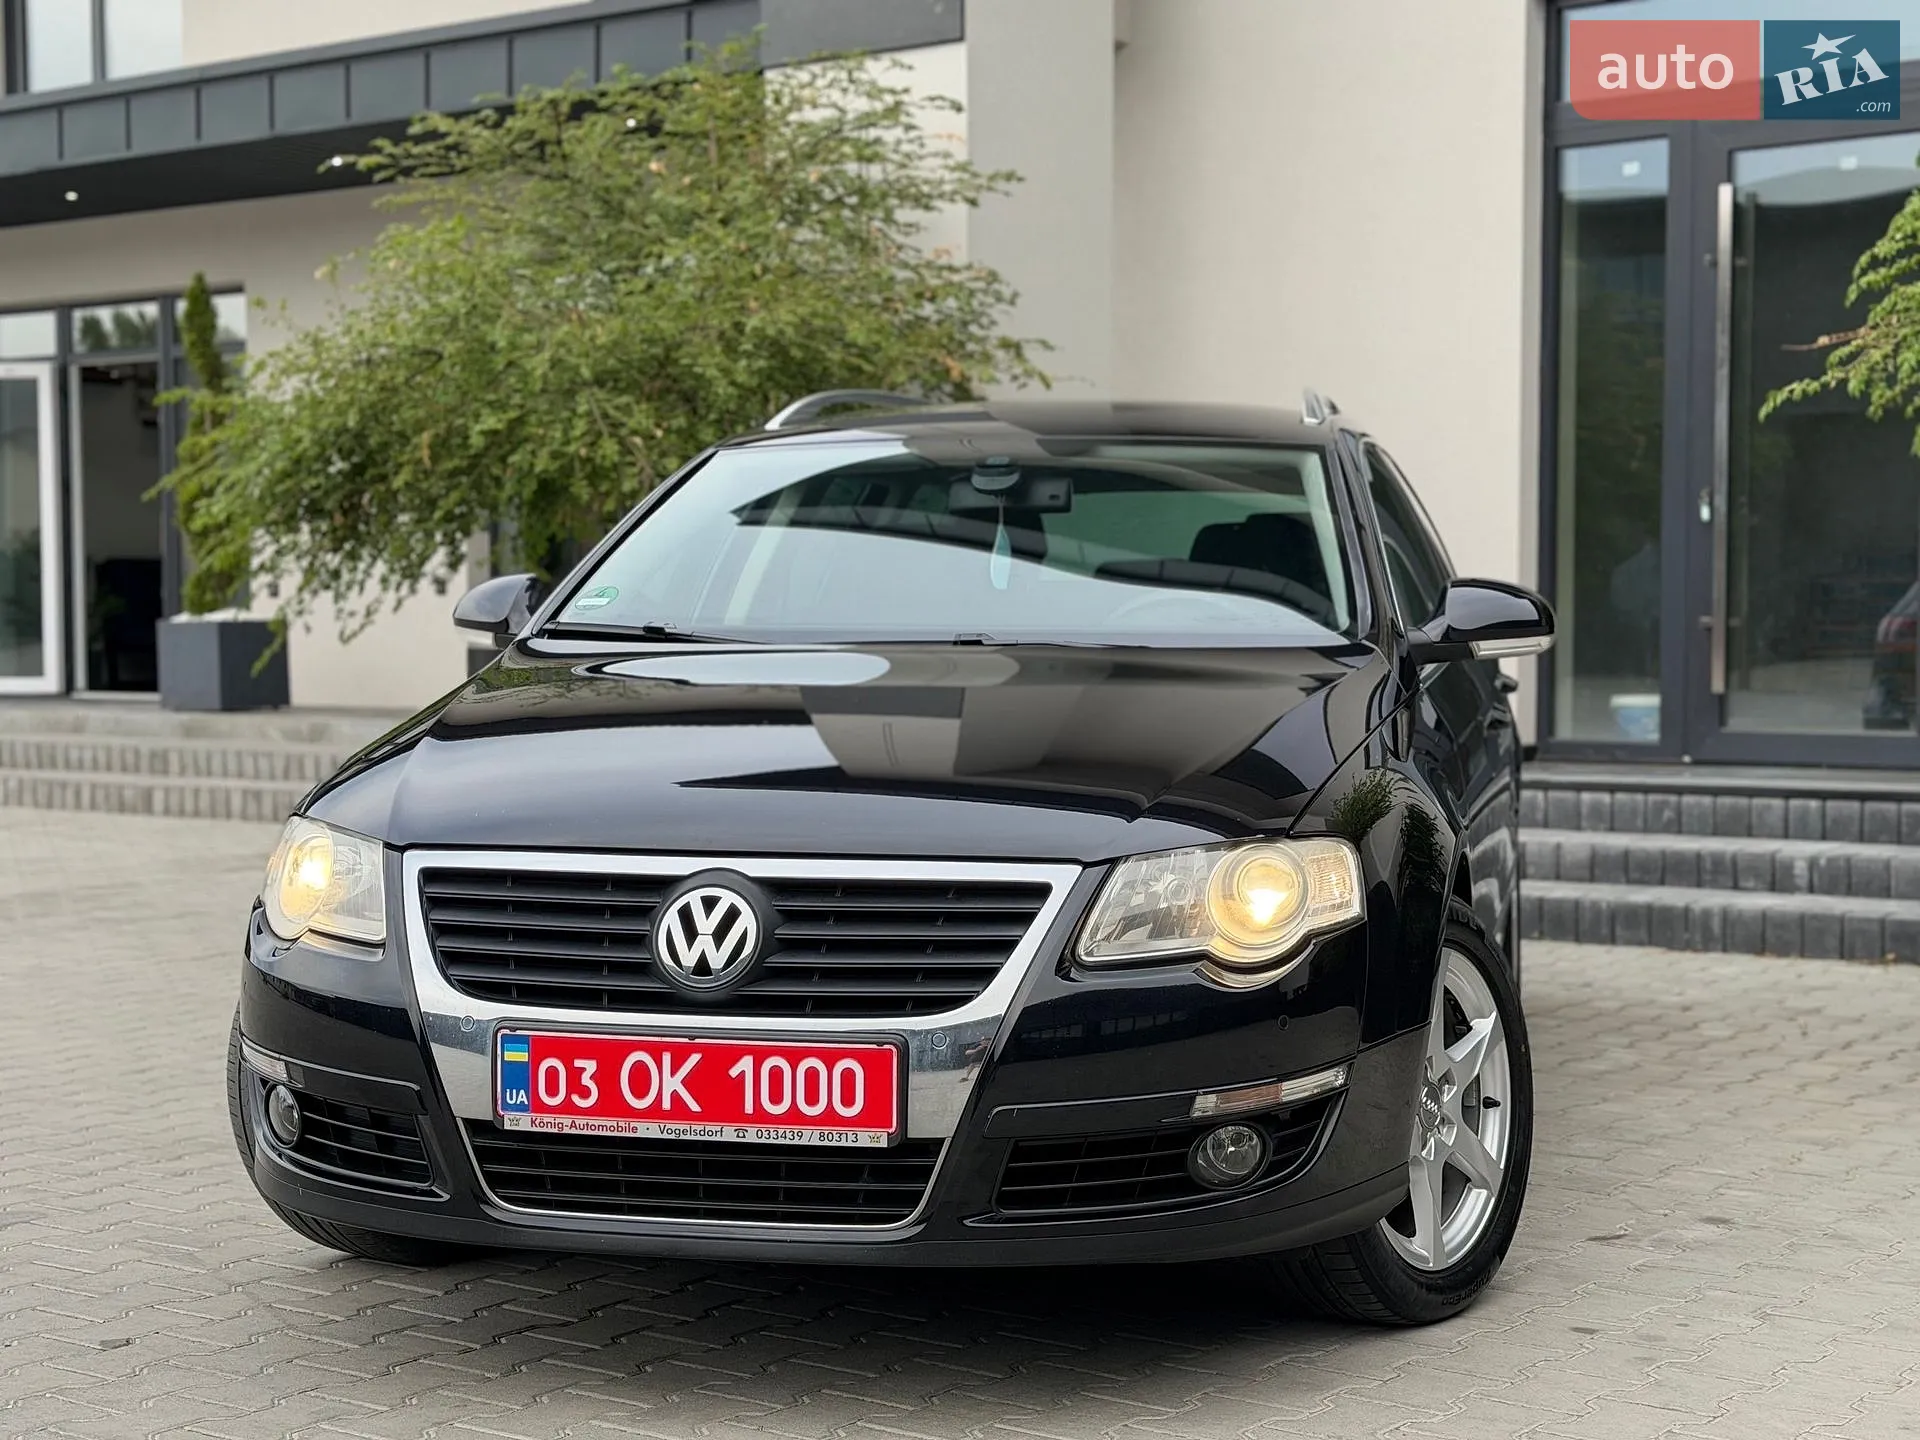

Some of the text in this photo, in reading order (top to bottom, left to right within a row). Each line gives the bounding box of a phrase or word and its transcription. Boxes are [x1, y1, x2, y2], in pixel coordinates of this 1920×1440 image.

[505, 1088, 528, 1105] UA
[537, 1050, 865, 1118] 03 OK 1000
[531, 1117, 639, 1134] König-Automobile
[658, 1124, 725, 1138] Vogelsdorf
[756, 1129, 804, 1141] 033439
[818, 1131, 859, 1143] 80313
